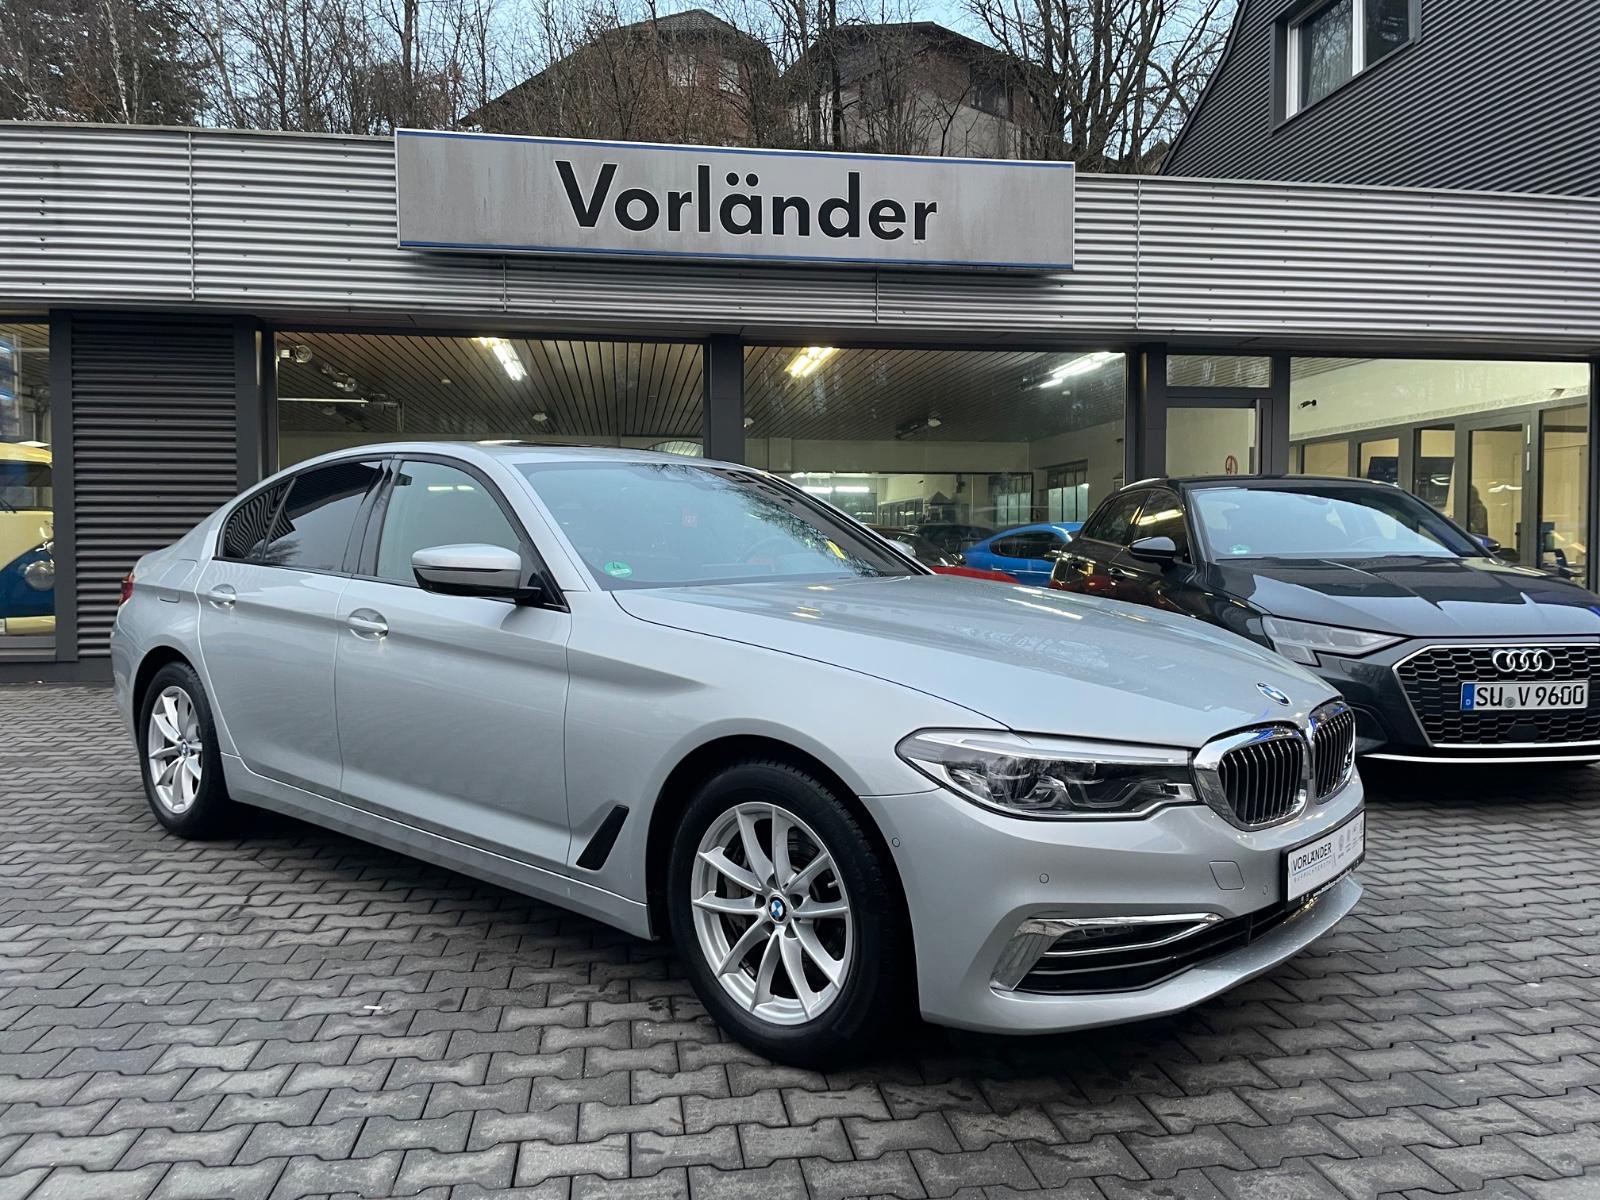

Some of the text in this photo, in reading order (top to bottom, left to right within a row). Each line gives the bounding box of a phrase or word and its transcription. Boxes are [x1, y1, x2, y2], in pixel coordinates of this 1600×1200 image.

[554, 160, 938, 241] Vorländer
[1475, 685, 1584, 707] SU V 9600
[1292, 842, 1332, 871] VORLÄNDER
